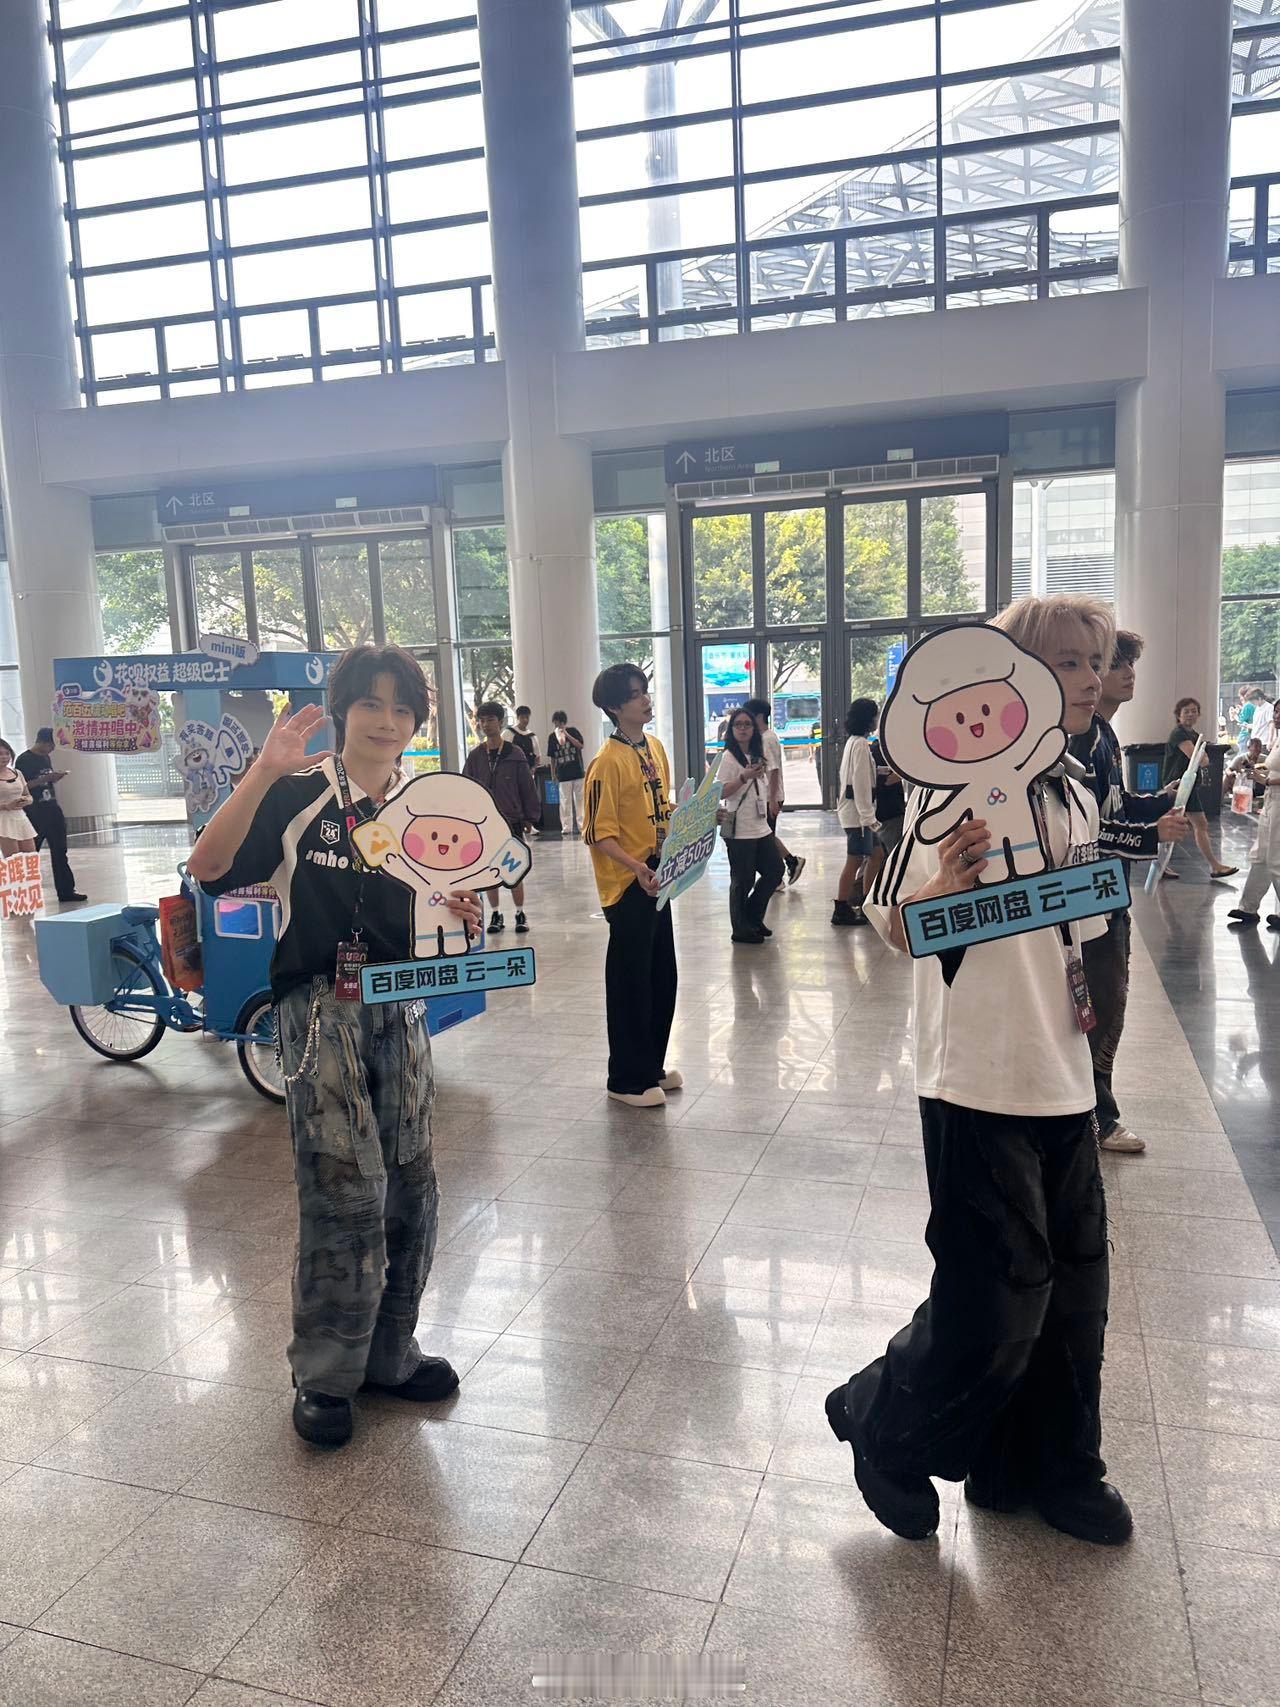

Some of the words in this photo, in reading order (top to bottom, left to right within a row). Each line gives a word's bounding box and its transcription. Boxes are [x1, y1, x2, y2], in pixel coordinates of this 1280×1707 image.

[704, 446, 736, 464] 北区
[189, 492, 216, 507] 北区
[210, 641, 247, 659] mini版
[115, 662, 171, 684] 花呗权益
[172, 661, 231, 683] 超级巴士
[72, 719, 138, 737] 激情开唱中
[501, 851, 522, 873] W
[661, 833, 714, 886] 立减50元
[0, 883, 44, 919] 下次见
[918, 888, 1033, 942] 百度网盘
[1038, 869, 1120, 914] 云一朵
[370, 964, 459, 995] 百度网盘
[465, 956, 527, 984] 云一朵
